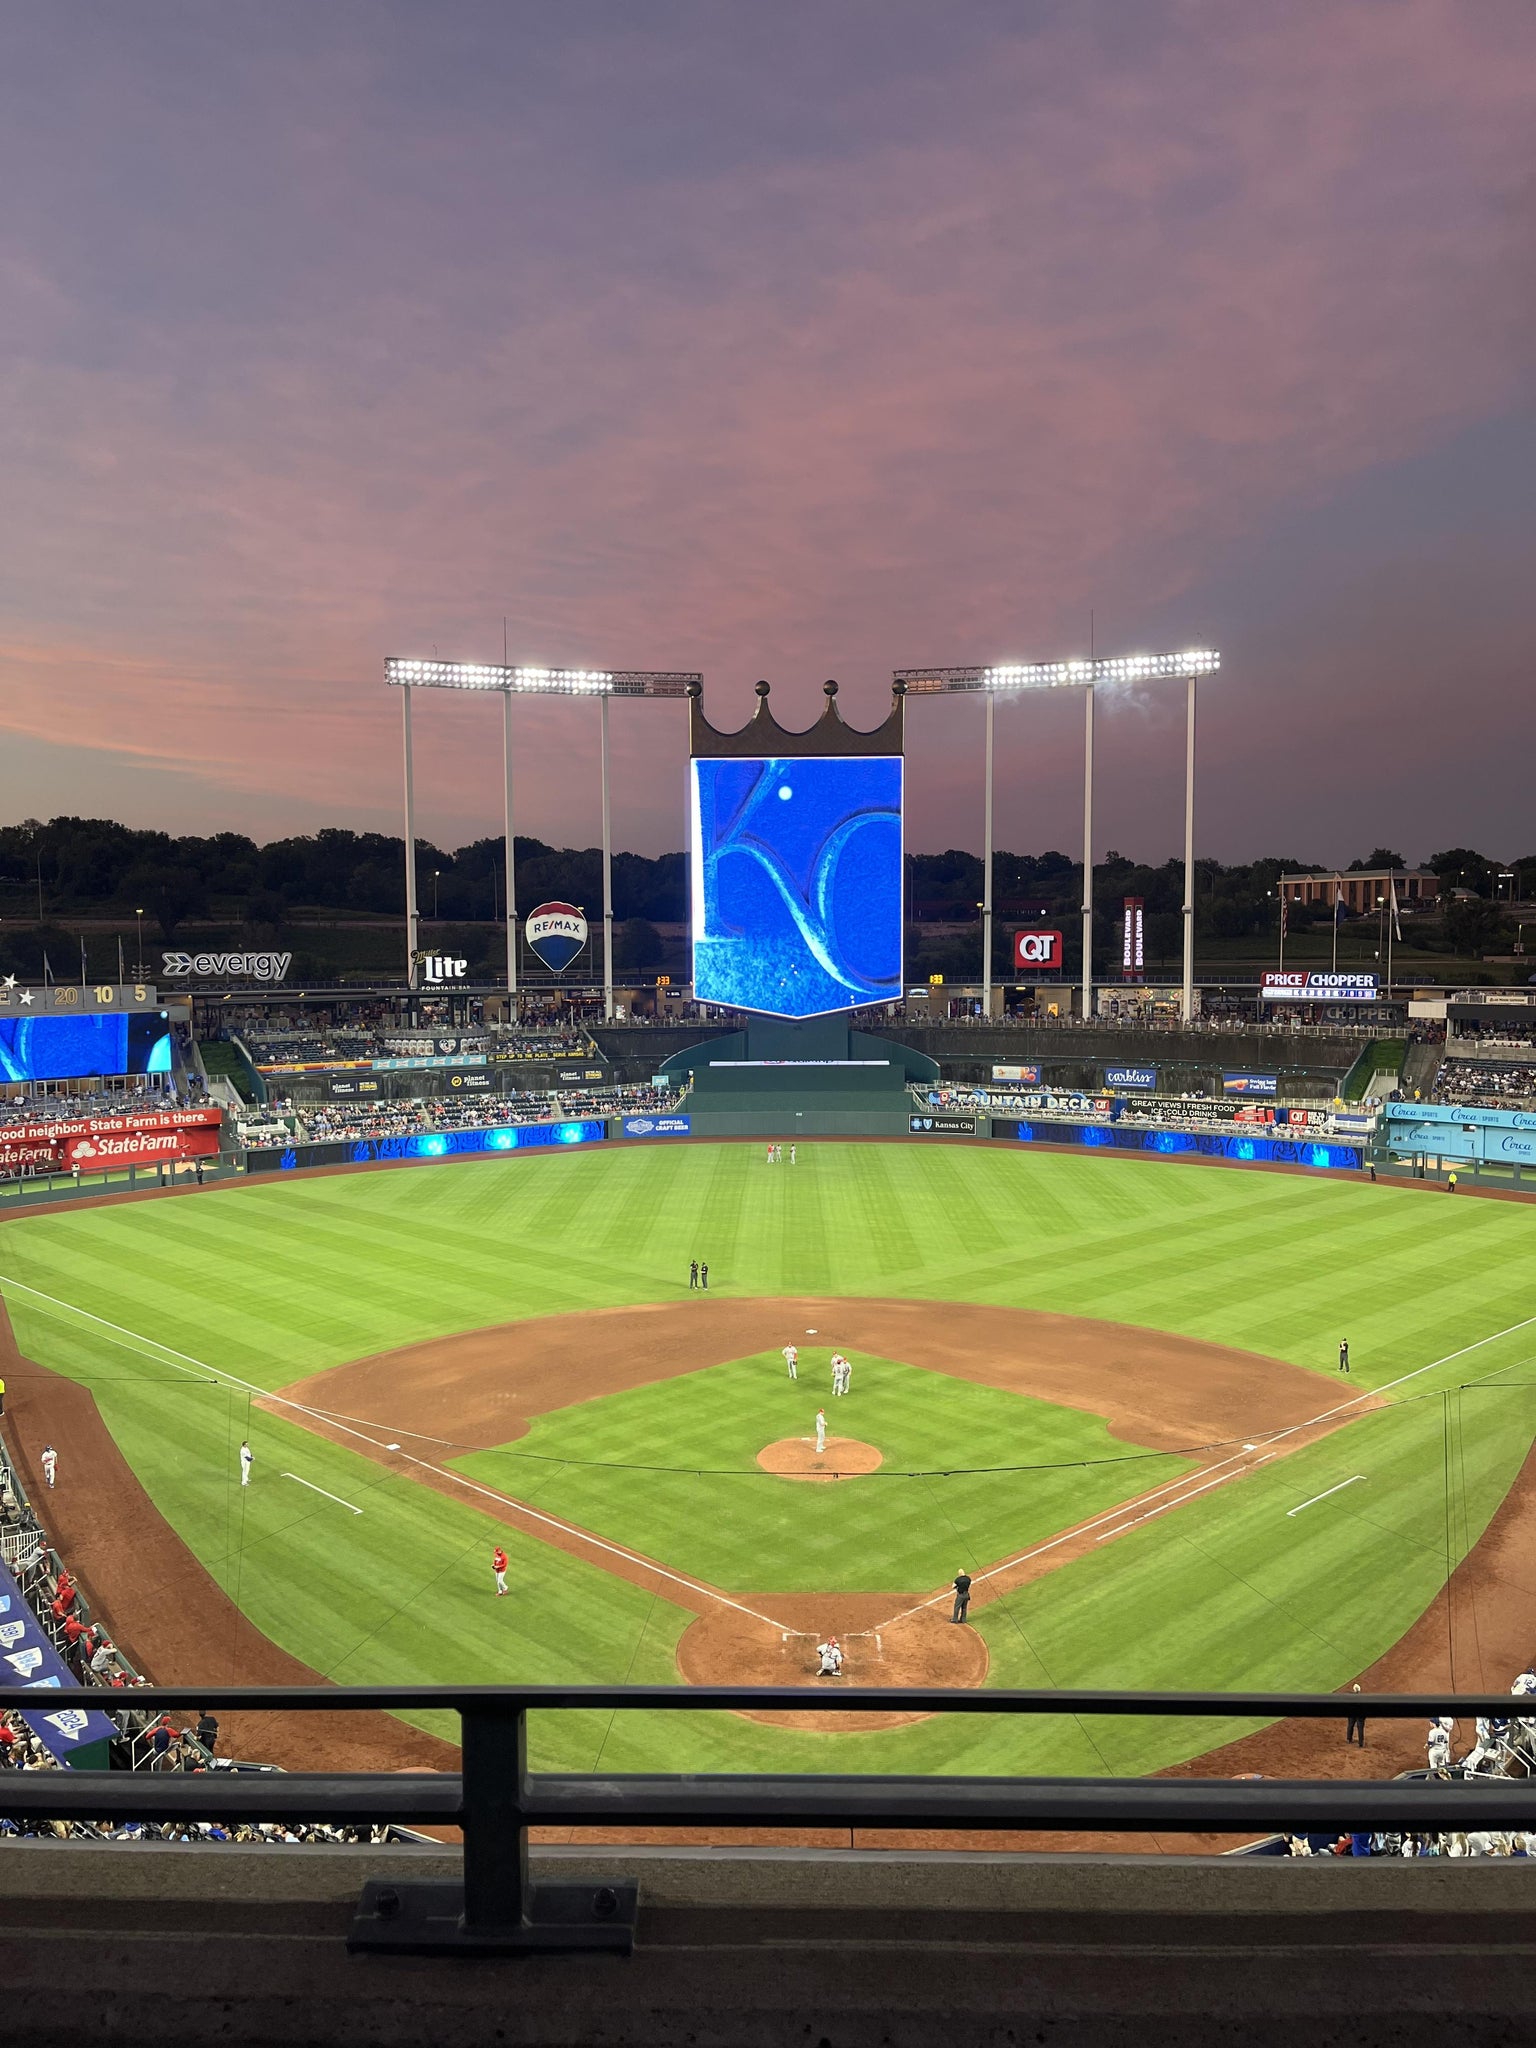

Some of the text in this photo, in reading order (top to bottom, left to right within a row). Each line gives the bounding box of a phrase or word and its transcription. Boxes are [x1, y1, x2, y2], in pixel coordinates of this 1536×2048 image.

[534, 920, 580, 933] RE/MAX
[1123, 909, 1132, 966] BOULEVARD
[1135, 909, 1143, 966] BOULEVARD
[1019, 934, 1055, 962] QT
[194, 952, 292, 980] evergy
[423, 956, 468, 984] Lite
[1265, 973, 1374, 987] PRICE CHOPPER
[54, 987, 78, 1006] 20
[93, 986, 114, 1003] 10
[134, 984, 147, 1002] 5
[464, 1075, 485, 1083] planet
[1107, 1069, 1153, 1083] carbliss
[1047, 1097, 1093, 1111] DECK
[1096, 1100, 1108, 1110] QT
[1391, 1104, 1417, 1117] Circa
[1190, 1110, 1218, 1118] DRINKS
[1291, 1111, 1305, 1122] QT
[1451, 1108, 1478, 1122] Circa
[0, 1112, 208, 1142] ood neighbor, State Farm is there.
[960, 1122, 974, 1130] City
[1502, 1136, 1533, 1152] Circa
[56, 1710, 81, 1730] 2024
